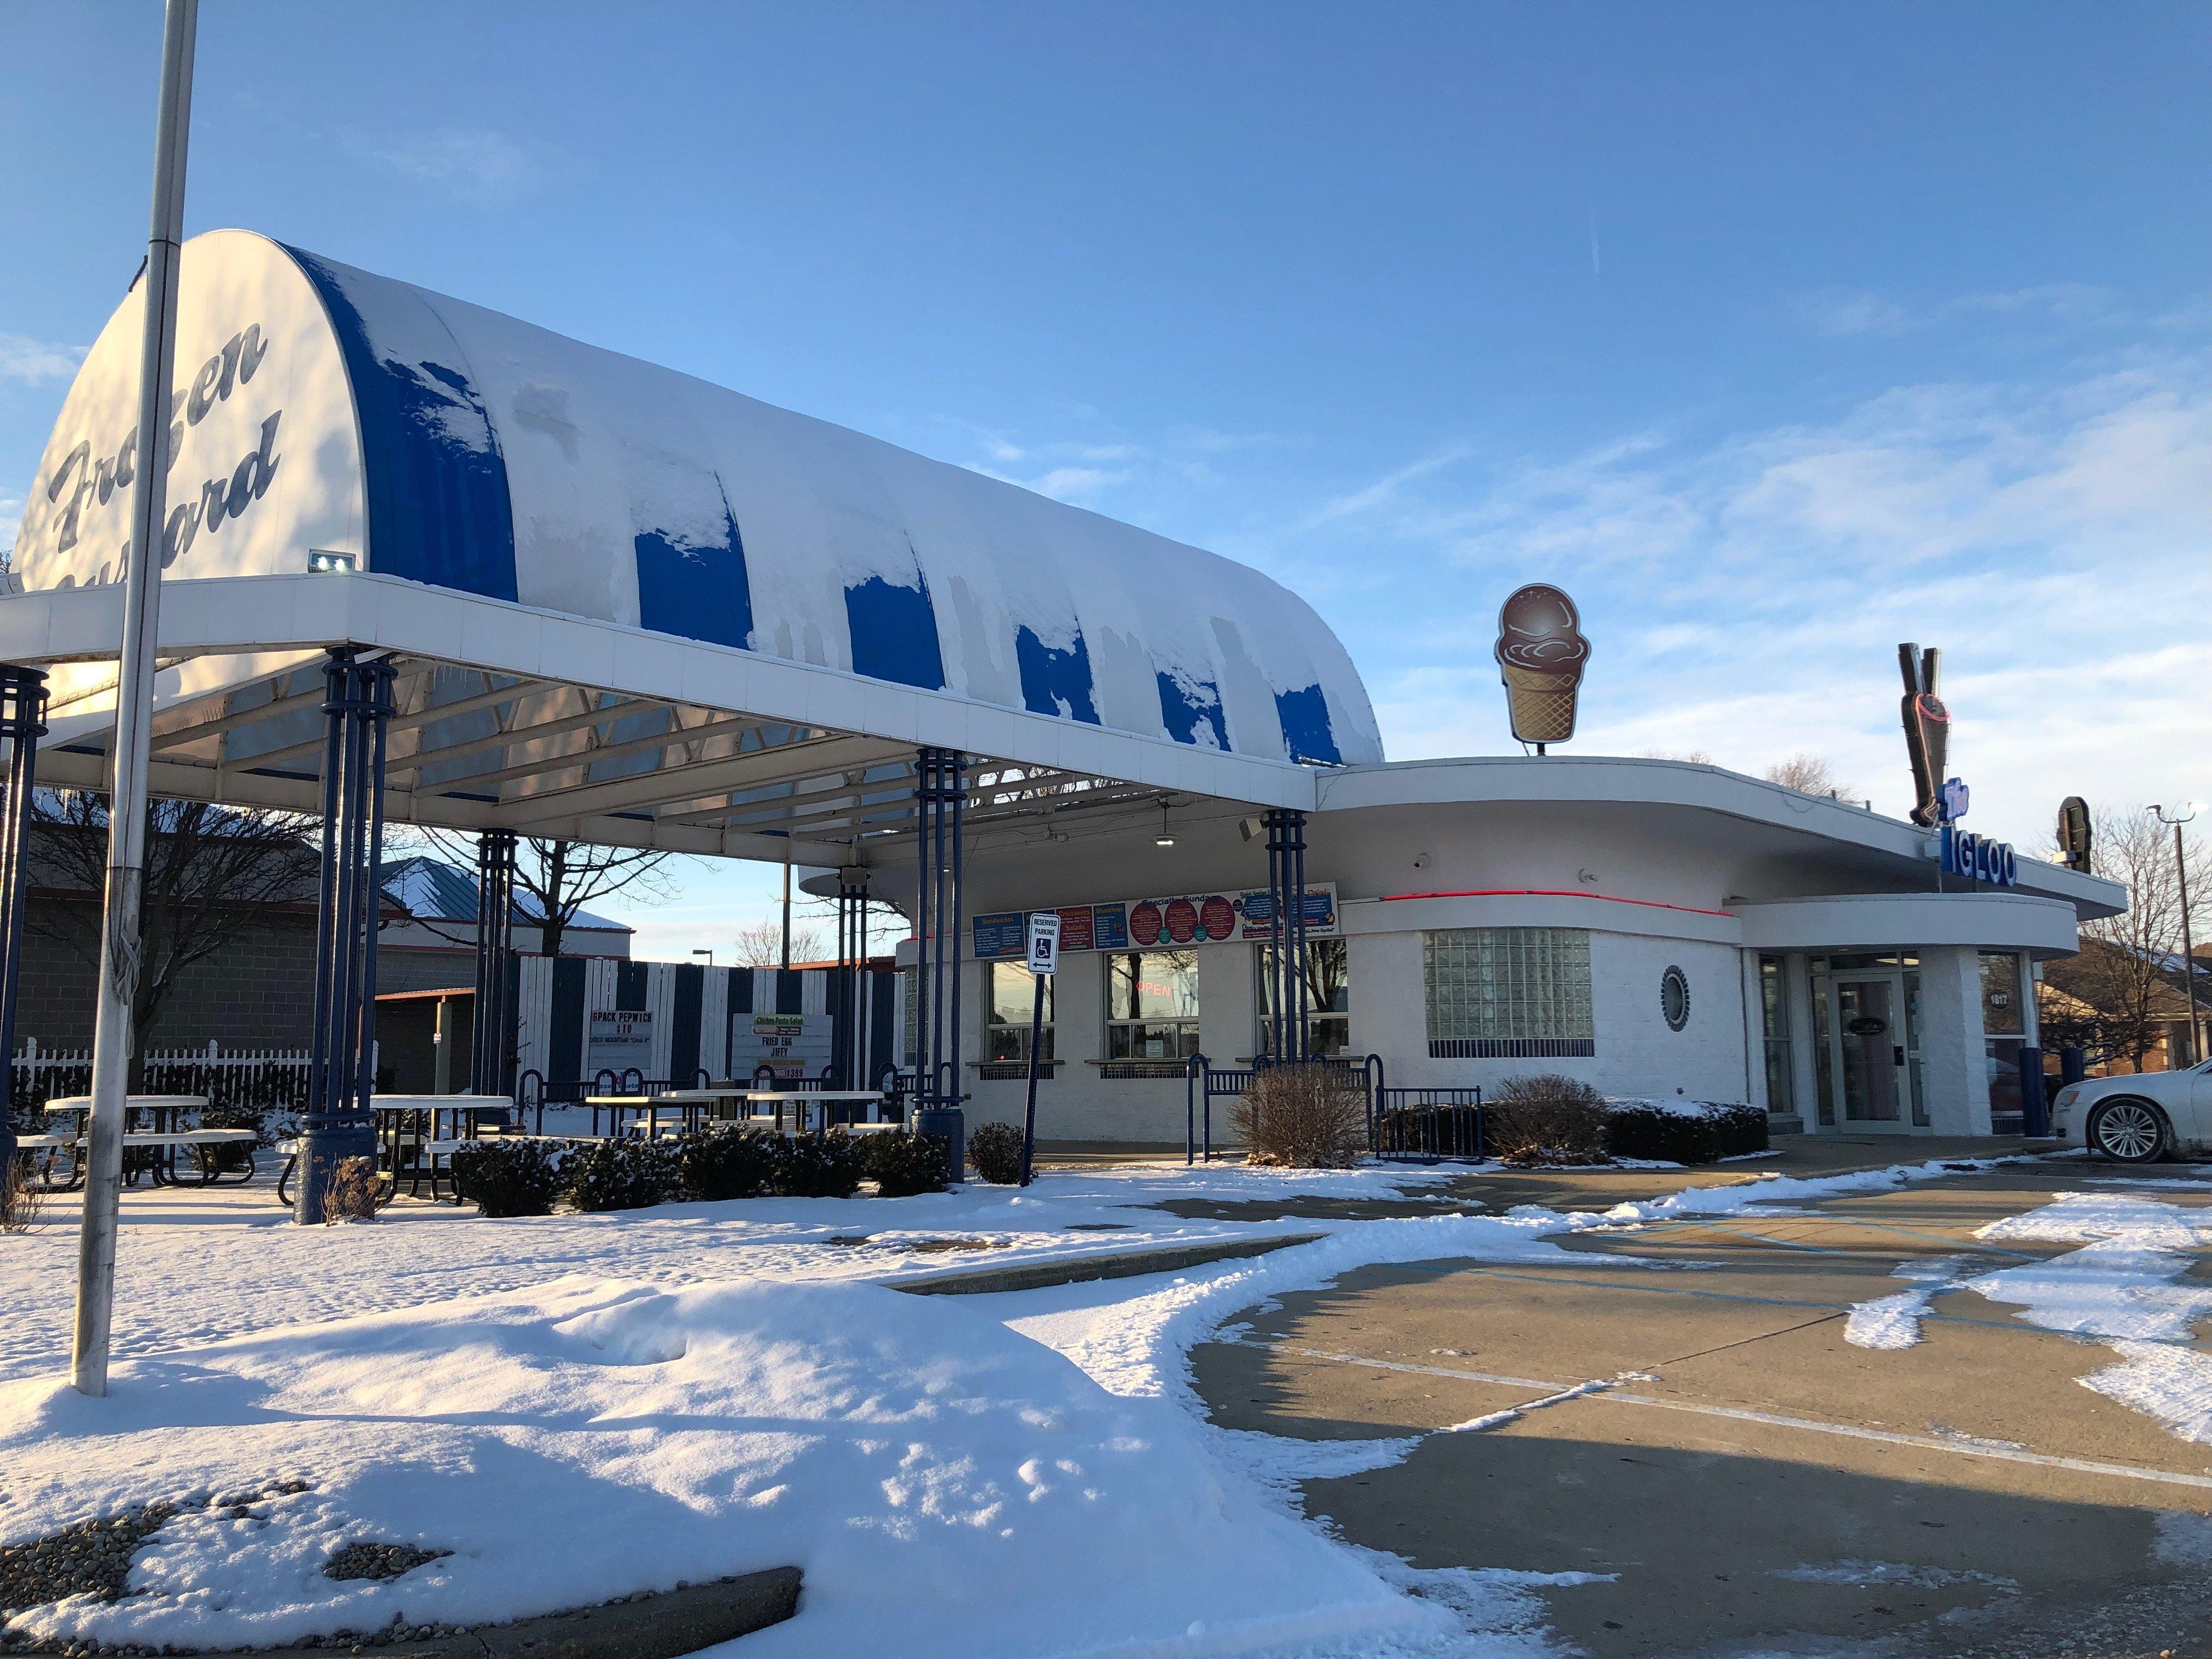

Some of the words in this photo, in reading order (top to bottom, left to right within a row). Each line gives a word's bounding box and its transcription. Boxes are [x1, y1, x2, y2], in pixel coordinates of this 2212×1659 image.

[1942, 826, 2017, 887] IGLOO
[1142, 898, 1179, 909] Specialty
[1183, 894, 1221, 902] Sundaes
[1034, 918, 1057, 927] RESERVED
[1136, 980, 1170, 997] OPEN
[592, 1012, 616, 1022] 6PACK
[619, 1012, 652, 1023] PEPWICH
[617, 1024, 632, 1034] $10
[762, 1036, 778, 1046] FRIED
[782, 1037, 792, 1046] EGG
[771, 1047, 788, 1057] JIFFY
